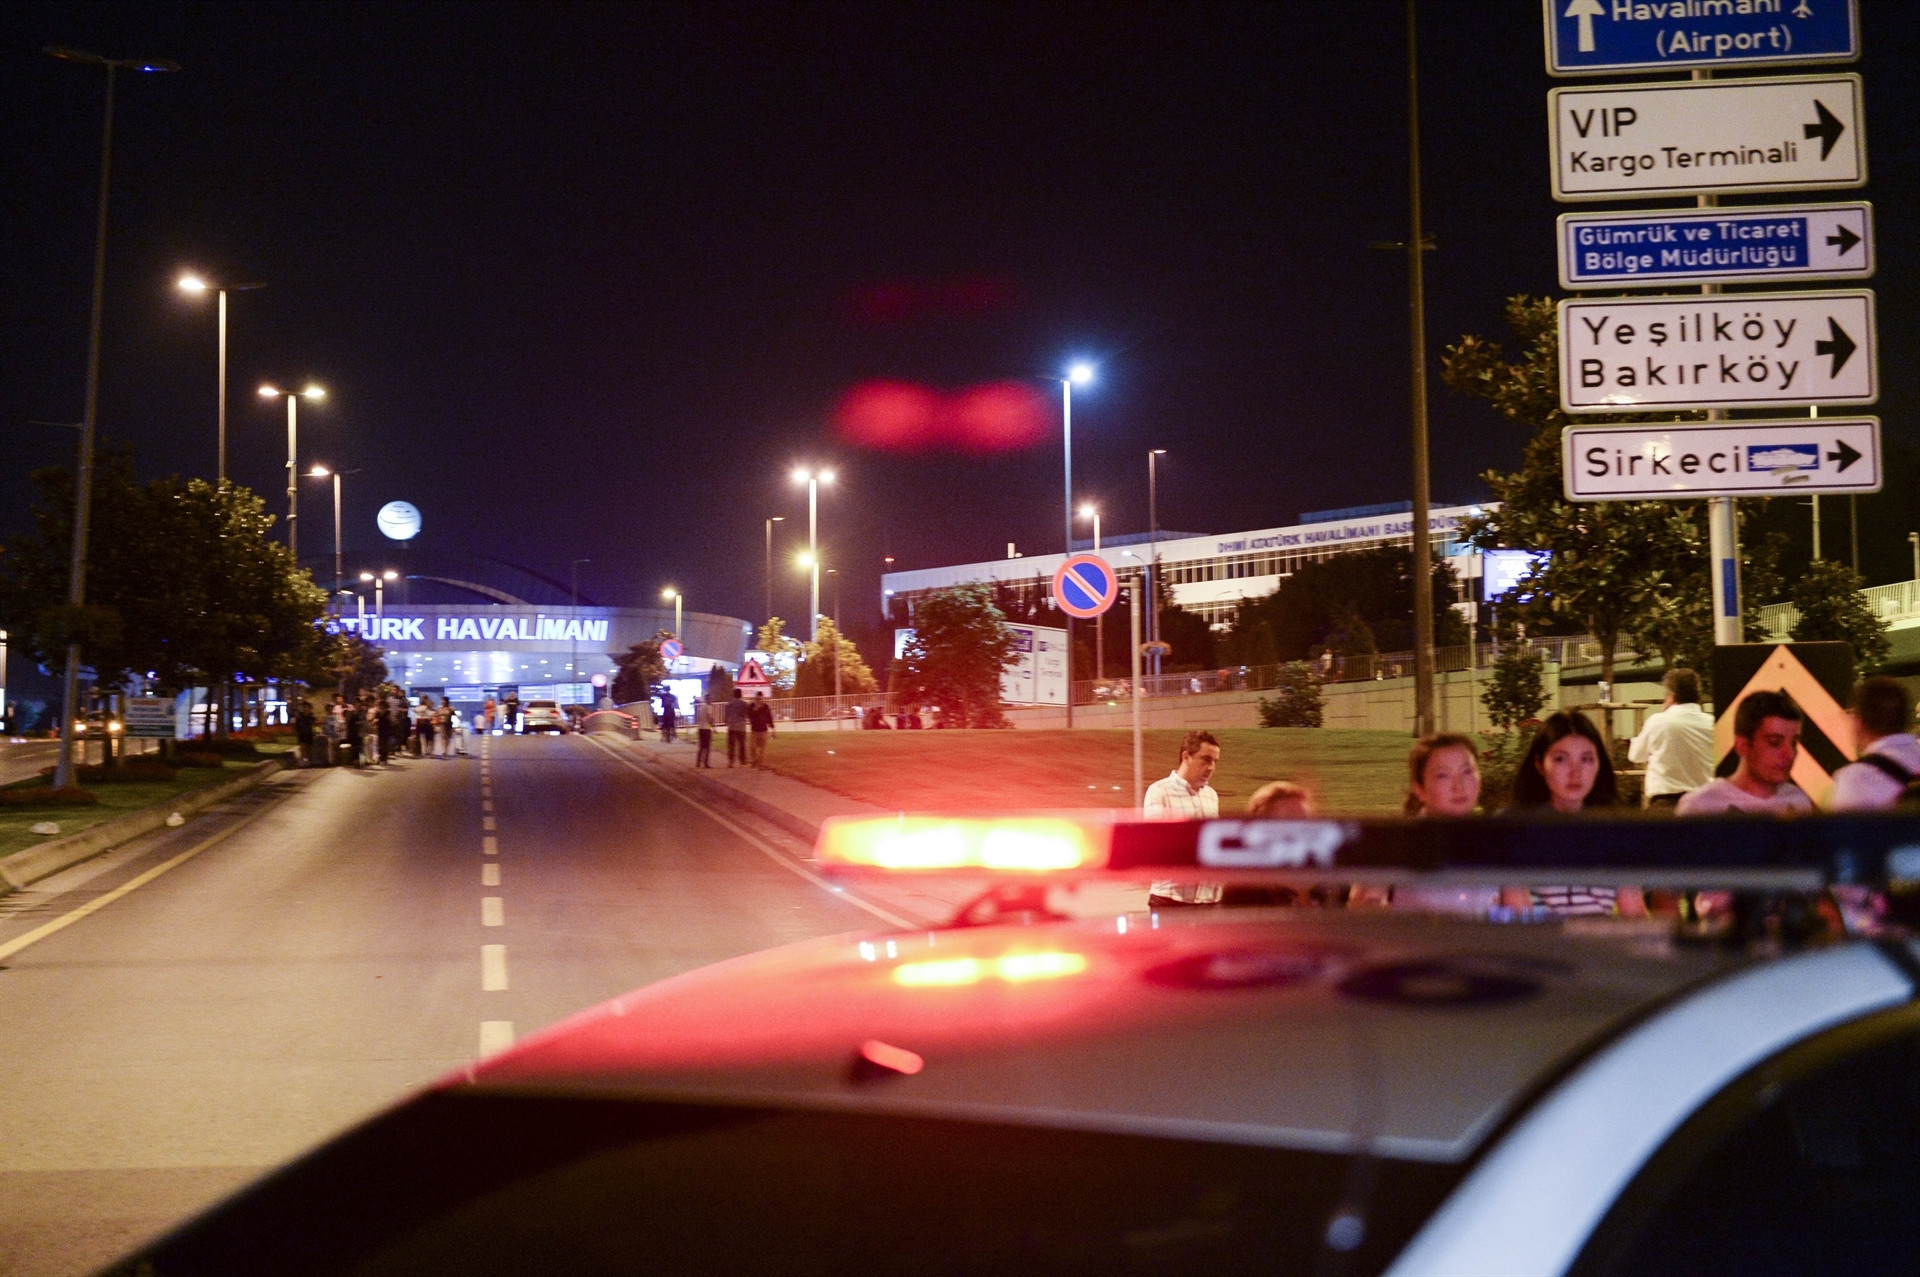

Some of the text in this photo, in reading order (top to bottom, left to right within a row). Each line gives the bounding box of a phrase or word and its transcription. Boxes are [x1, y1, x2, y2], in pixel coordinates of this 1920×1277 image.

[1656, 24, 1793, 57] (Airport)
[1570, 107, 1638, 138] VIP
[1571, 141, 1797, 177] Kargo Terminali
[1578, 221, 1802, 246] Gümrük ve Ticaret
[1584, 245, 1797, 272] Bölge Müdürlüğü
[1581, 312, 1797, 348] Yeşilköy
[1580, 354, 1800, 390] Bakırköy
[1586, 445, 1741, 477] Sirkeci
[1250, 533, 1301, 549] ATATÜRK
[1304, 524, 1381, 543] HAVALİMANI
[438, 614, 609, 641] HAVALİMANI
